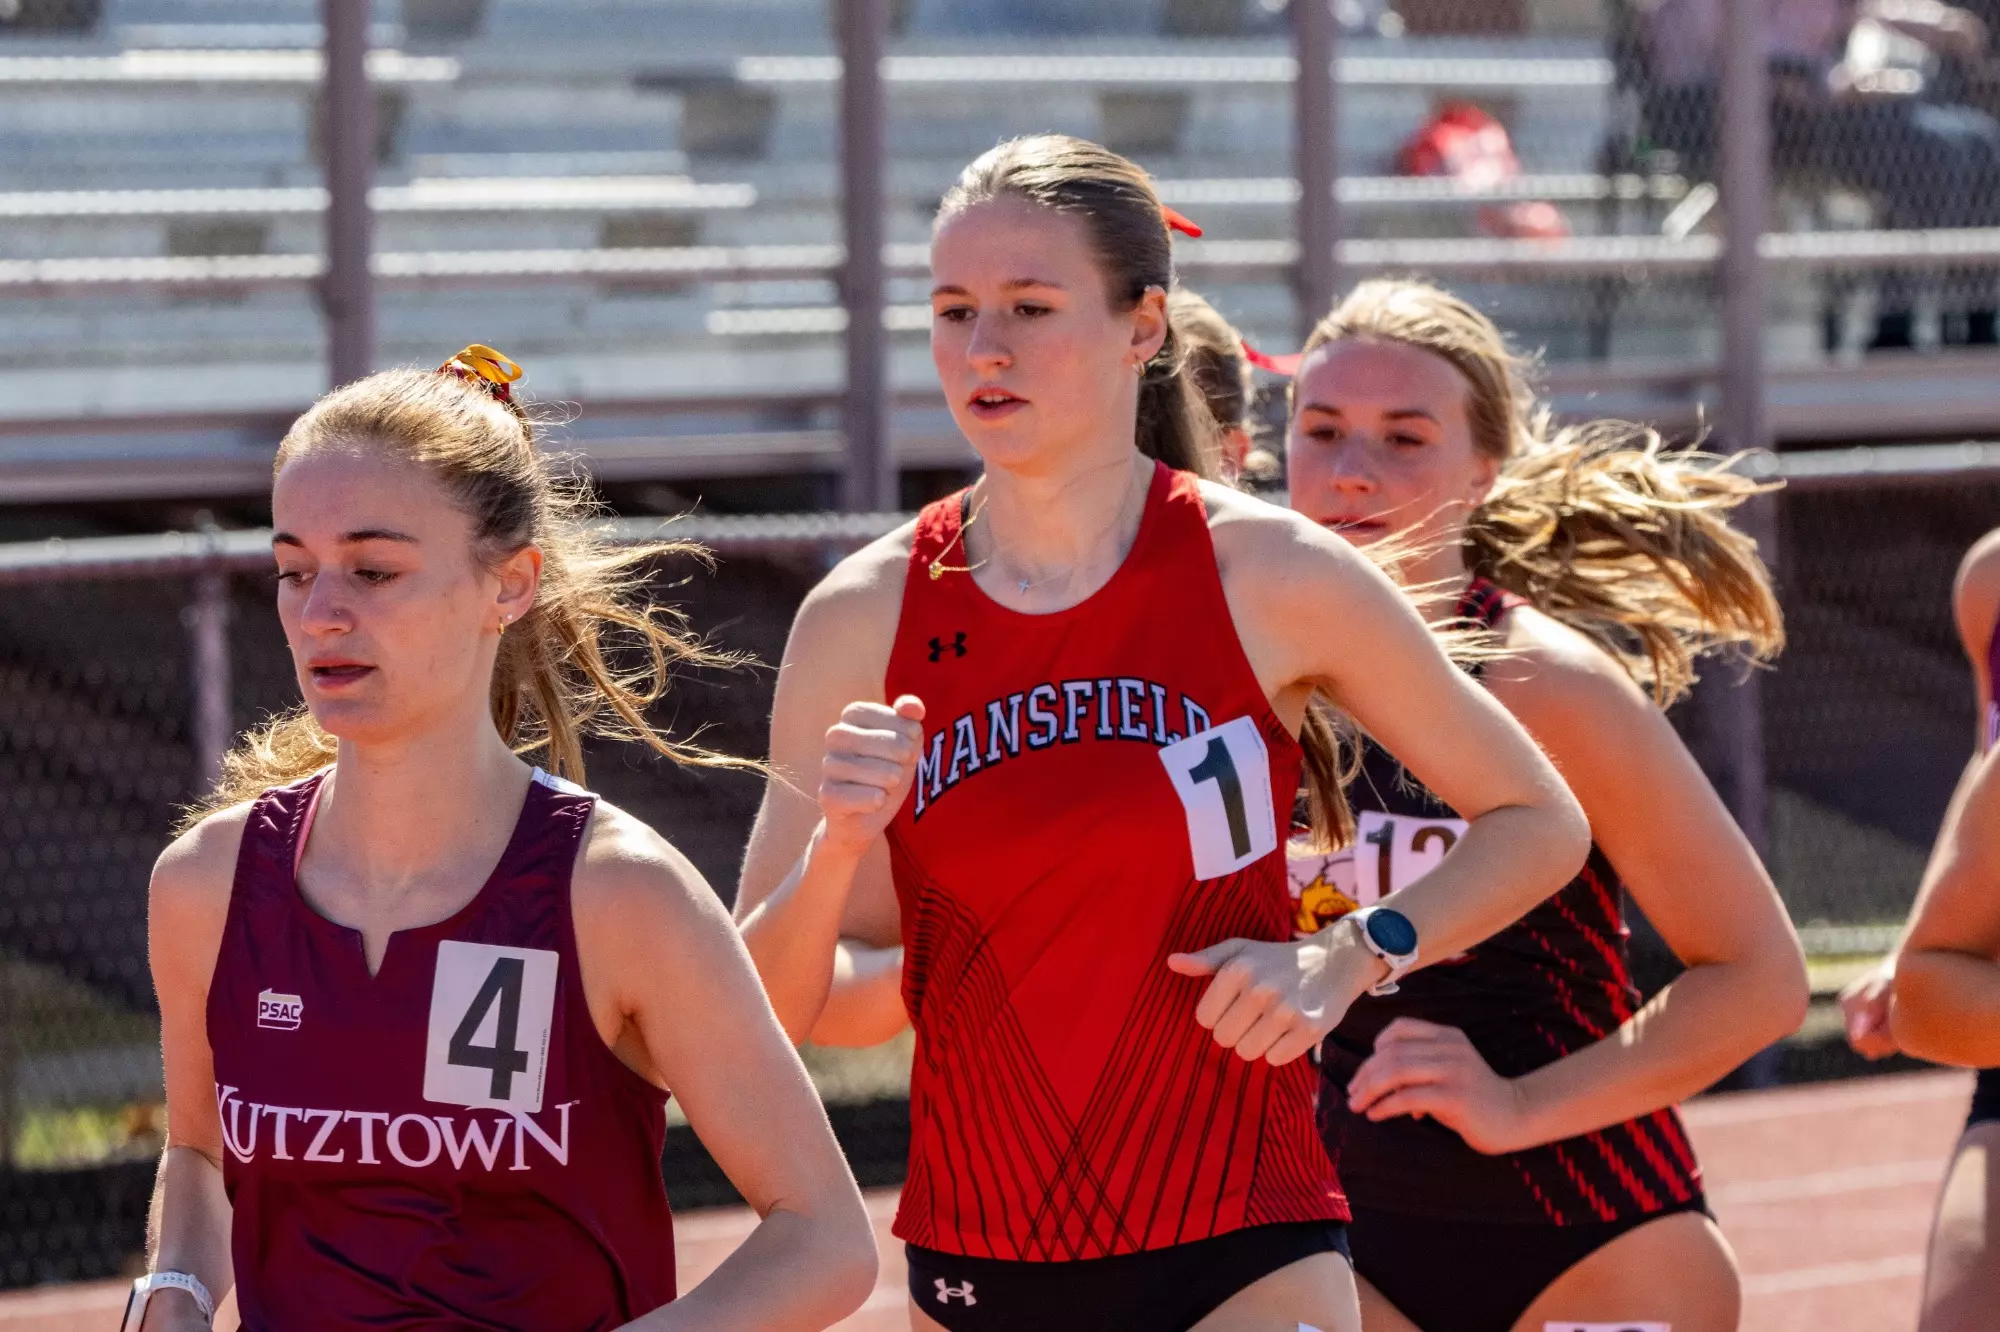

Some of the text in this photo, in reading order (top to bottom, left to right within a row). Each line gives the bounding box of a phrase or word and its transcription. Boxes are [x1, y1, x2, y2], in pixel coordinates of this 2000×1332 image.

[914, 676, 1212, 822] MANSFIELD
[1188, 736, 1252, 861] 1
[259, 1001, 300, 1020] PSAC
[448, 957, 529, 1101] 4
